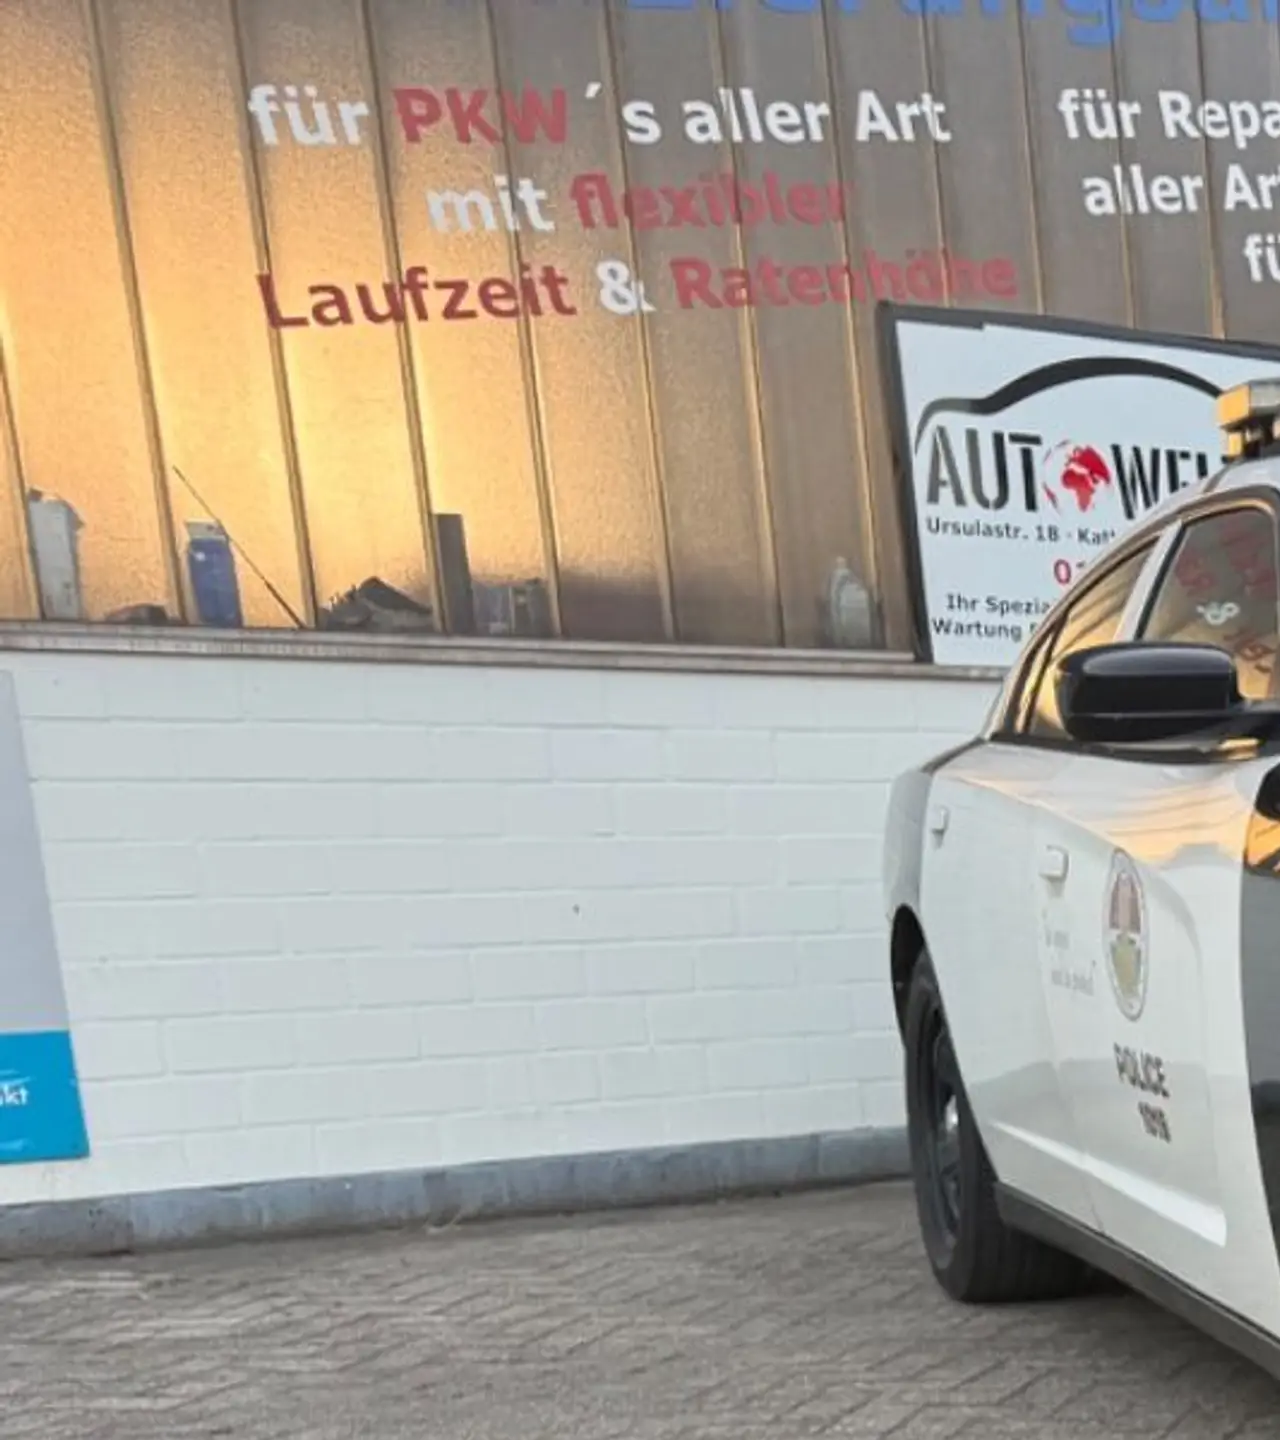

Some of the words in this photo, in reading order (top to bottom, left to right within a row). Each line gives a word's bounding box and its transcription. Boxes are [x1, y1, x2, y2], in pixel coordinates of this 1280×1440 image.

[248, 84, 369, 147] für
[392, 79, 568, 145] PKW
[683, 87, 830, 143] aller
[856, 90, 953, 143] Art
[1057, 89, 1141, 139] für
[427, 175, 555, 233] mit
[569, 168, 853, 233] flexibler
[1082, 164, 1204, 216] aller
[256, 264, 577, 328] Laufzeit
[596, 259, 655, 315] &
[669, 249, 1018, 310] Ratenhöhe
[925, 517, 1029, 541] Ursulastr.
[945, 594, 976, 613] Ihr
[932, 620, 1022, 644] Wartung
[1112, 1041, 1171, 1099] POLICE
